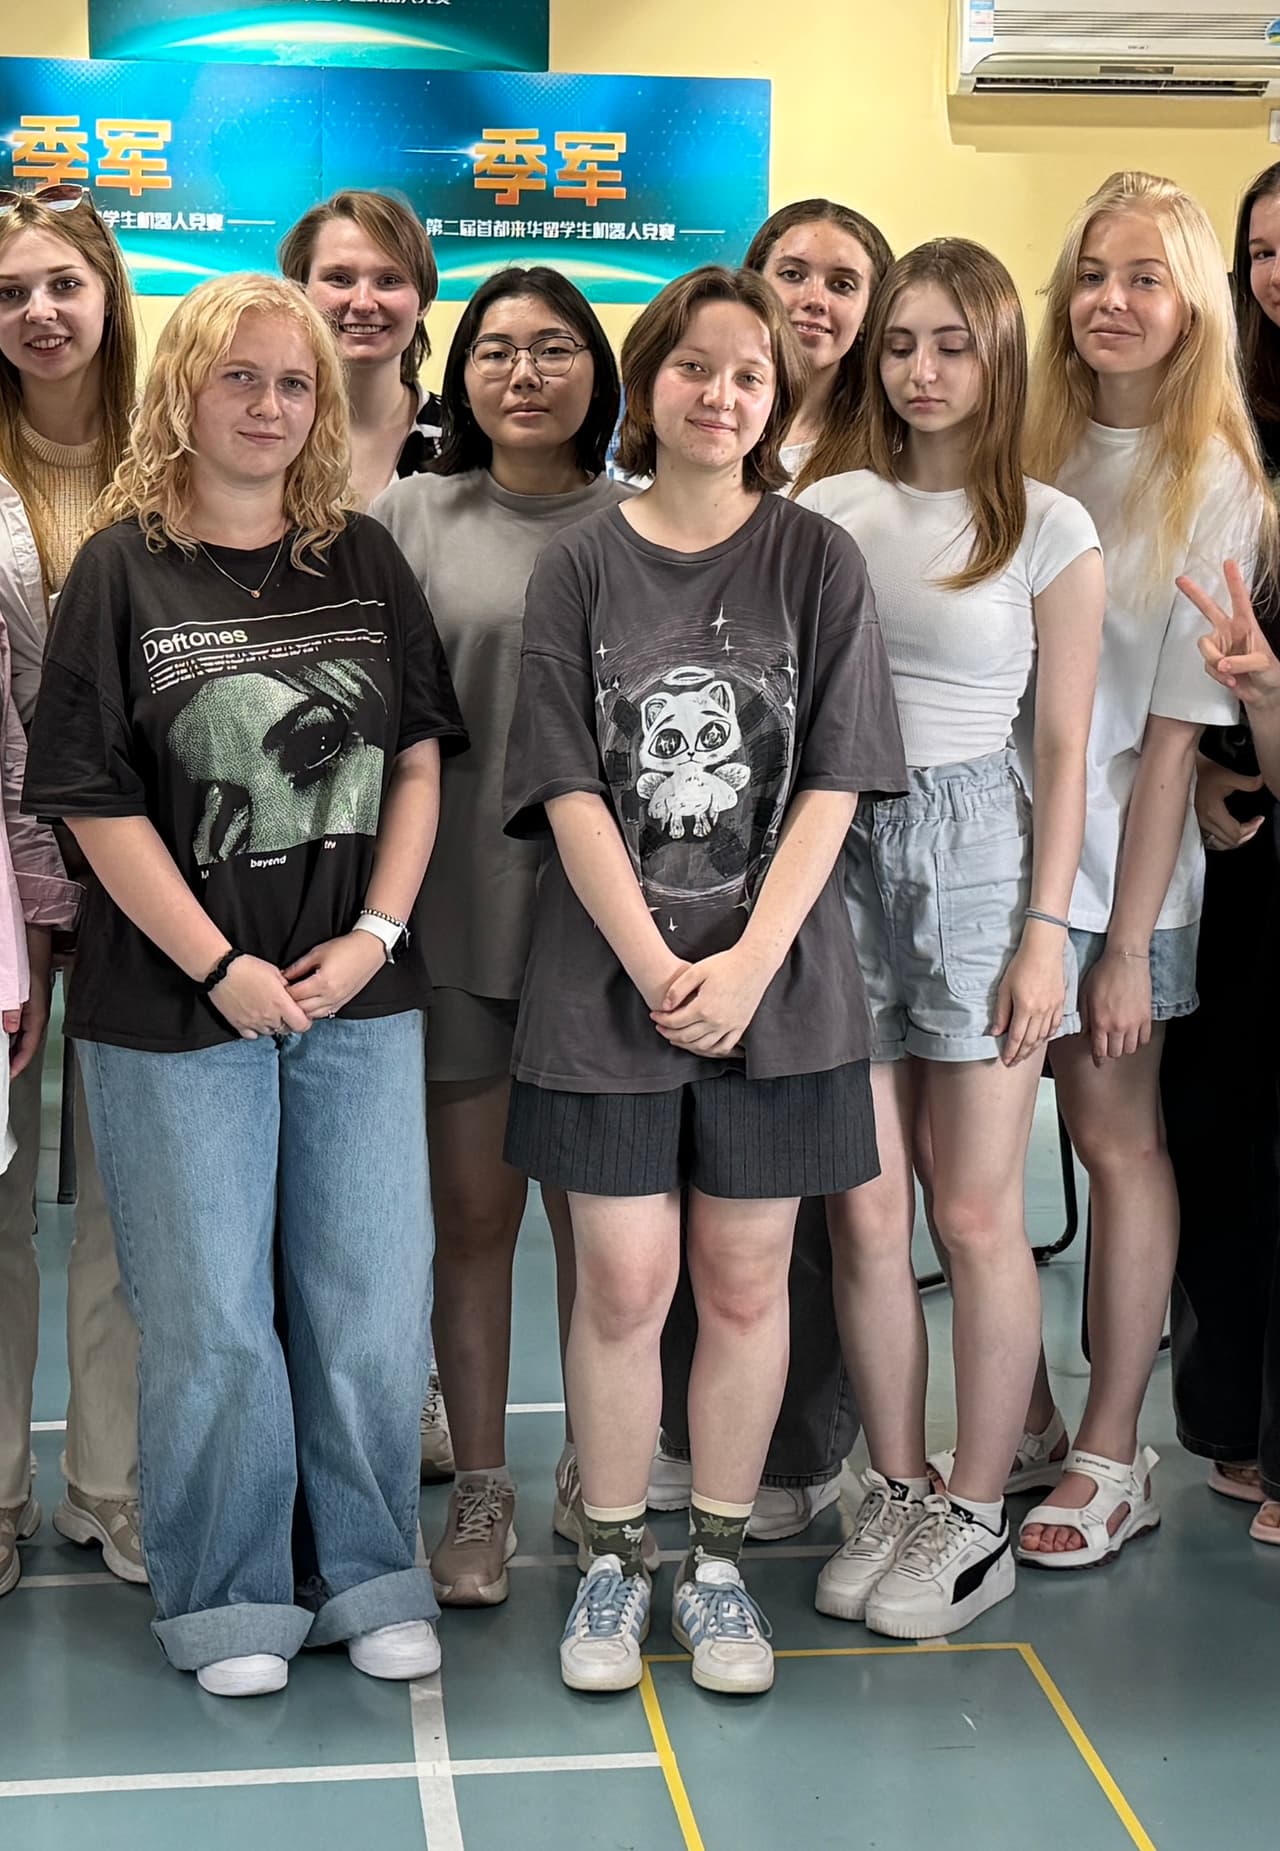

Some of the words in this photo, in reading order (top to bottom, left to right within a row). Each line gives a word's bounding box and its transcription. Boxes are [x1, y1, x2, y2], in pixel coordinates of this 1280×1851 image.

[12, 115, 172, 196] 季军
[474, 128, 626, 207] 季军
[95, 210, 224, 232] 学生机器人竞赛
[426, 218, 676, 241] 第二届首都来华留学生机器人竞赛
[142, 629, 248, 664] Deftones
